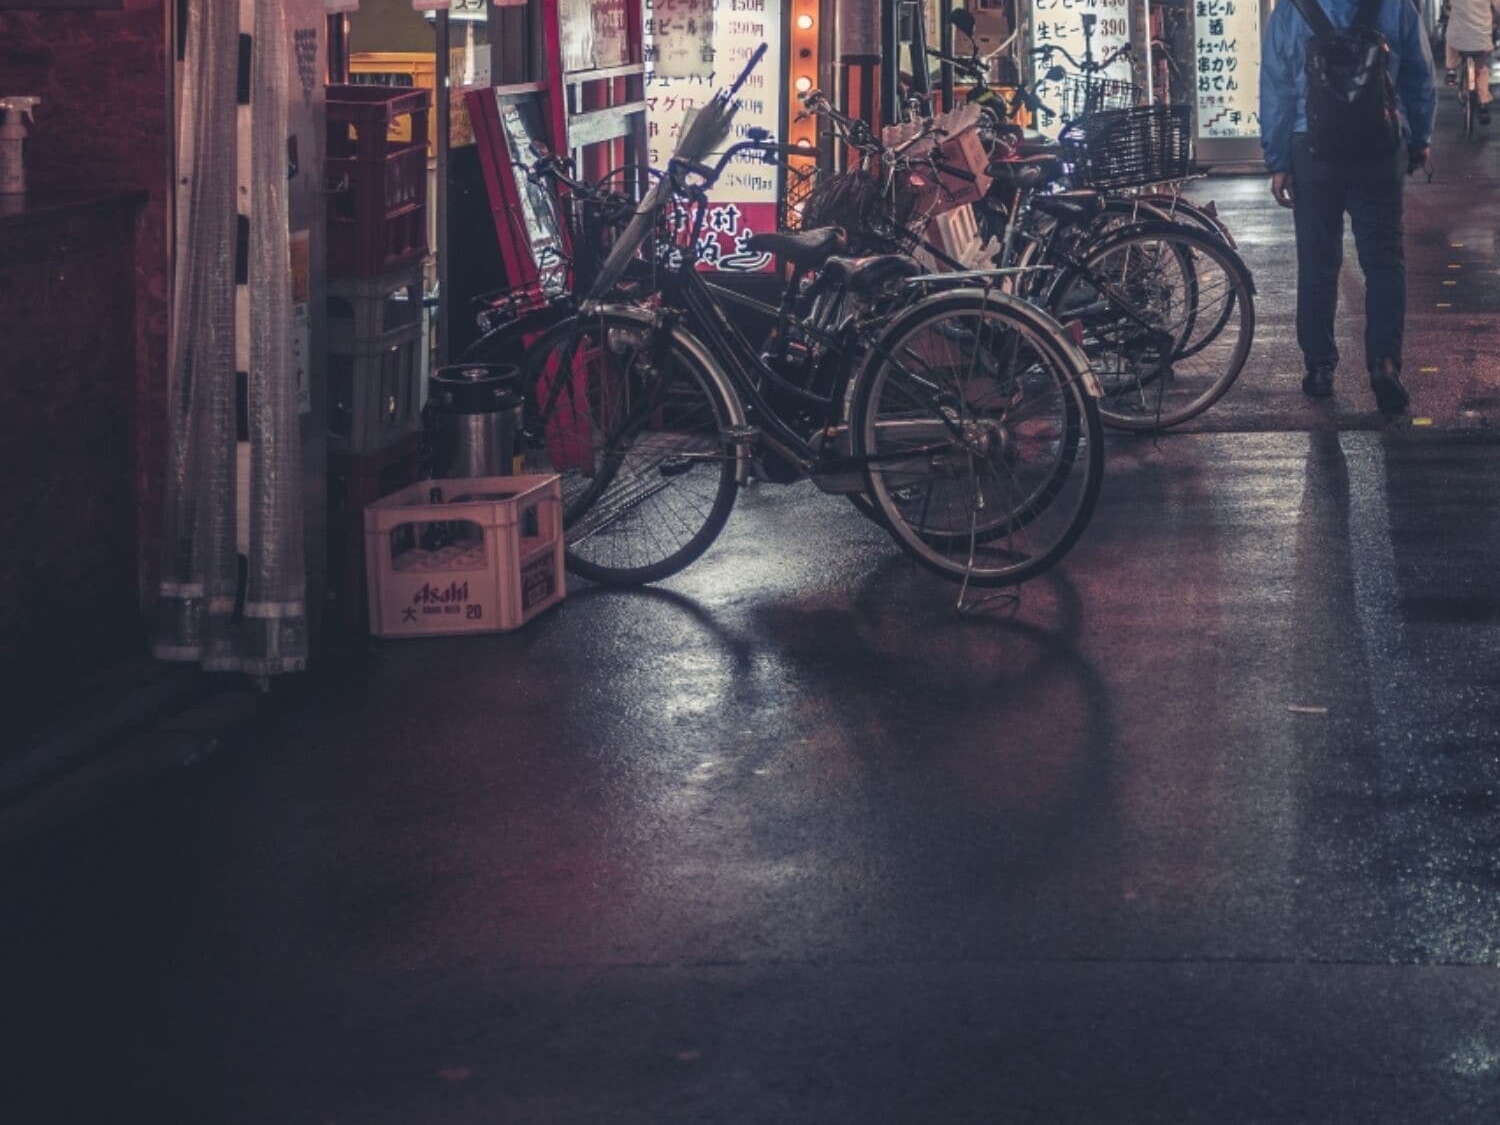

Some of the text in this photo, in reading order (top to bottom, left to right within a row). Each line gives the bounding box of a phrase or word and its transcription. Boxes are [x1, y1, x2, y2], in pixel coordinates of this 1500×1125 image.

[1101, 19, 1127, 37] 390
[1198, 75, 1238, 92] おでん
[413, 580, 469, 604] Asahi
[466, 603, 483, 620] 20
